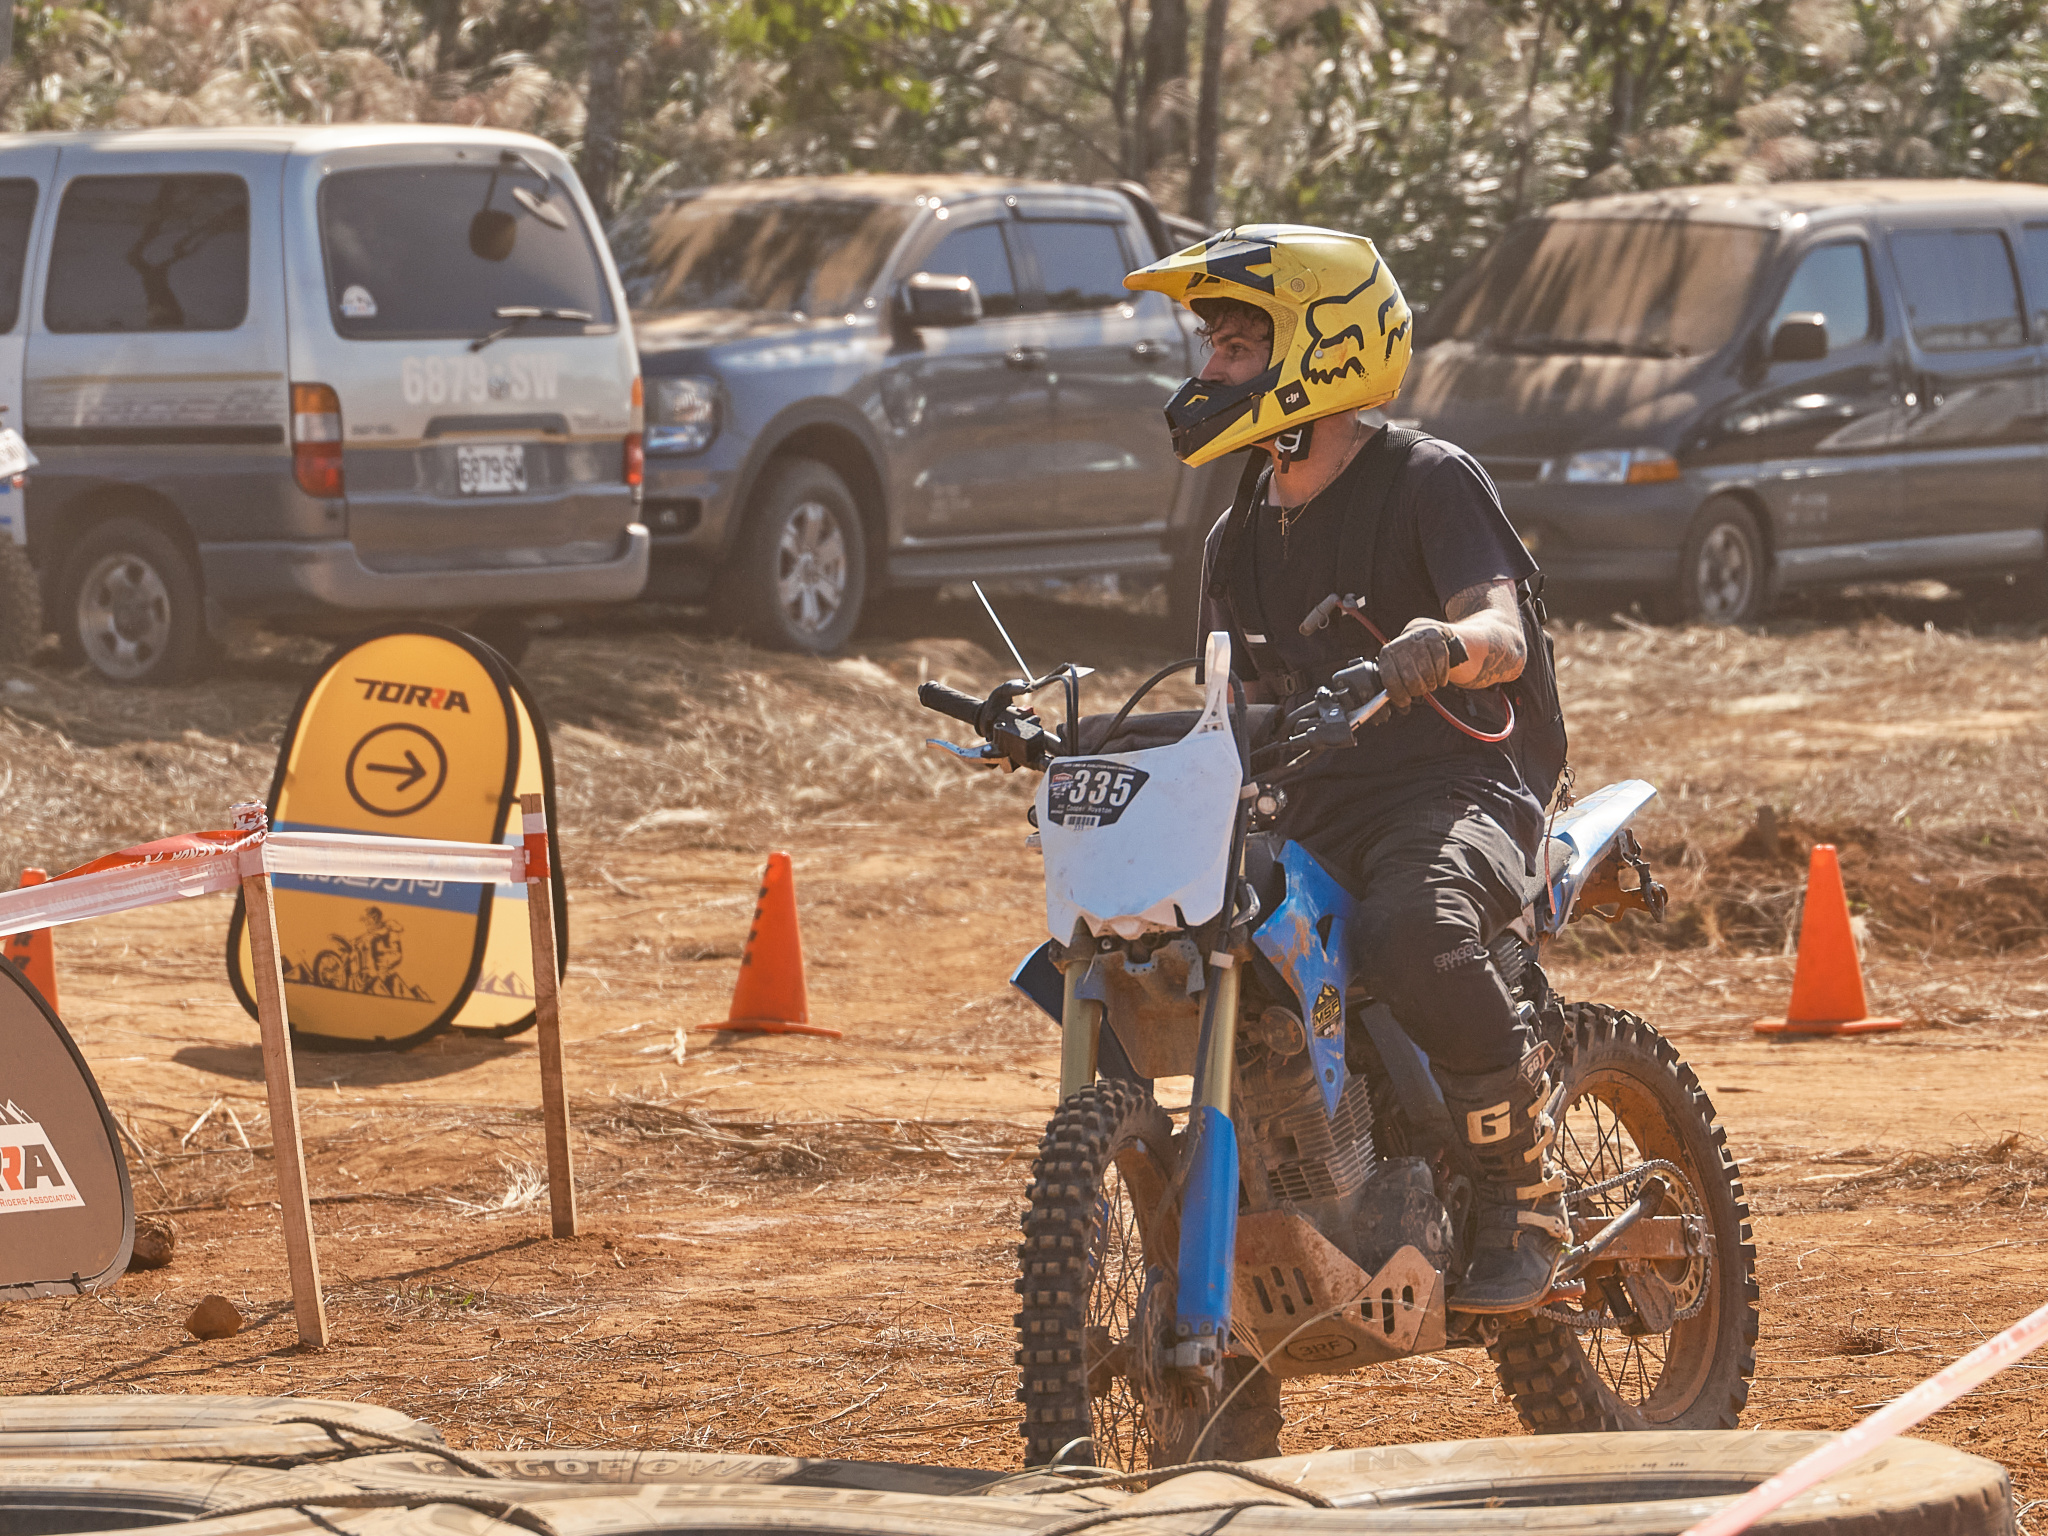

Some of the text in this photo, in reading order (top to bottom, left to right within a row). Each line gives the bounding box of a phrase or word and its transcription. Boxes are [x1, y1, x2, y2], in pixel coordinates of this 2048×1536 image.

[354, 677, 470, 714] TORRA
[1068, 770, 1134, 806] 335
[1467, 1101, 1511, 1144] G
